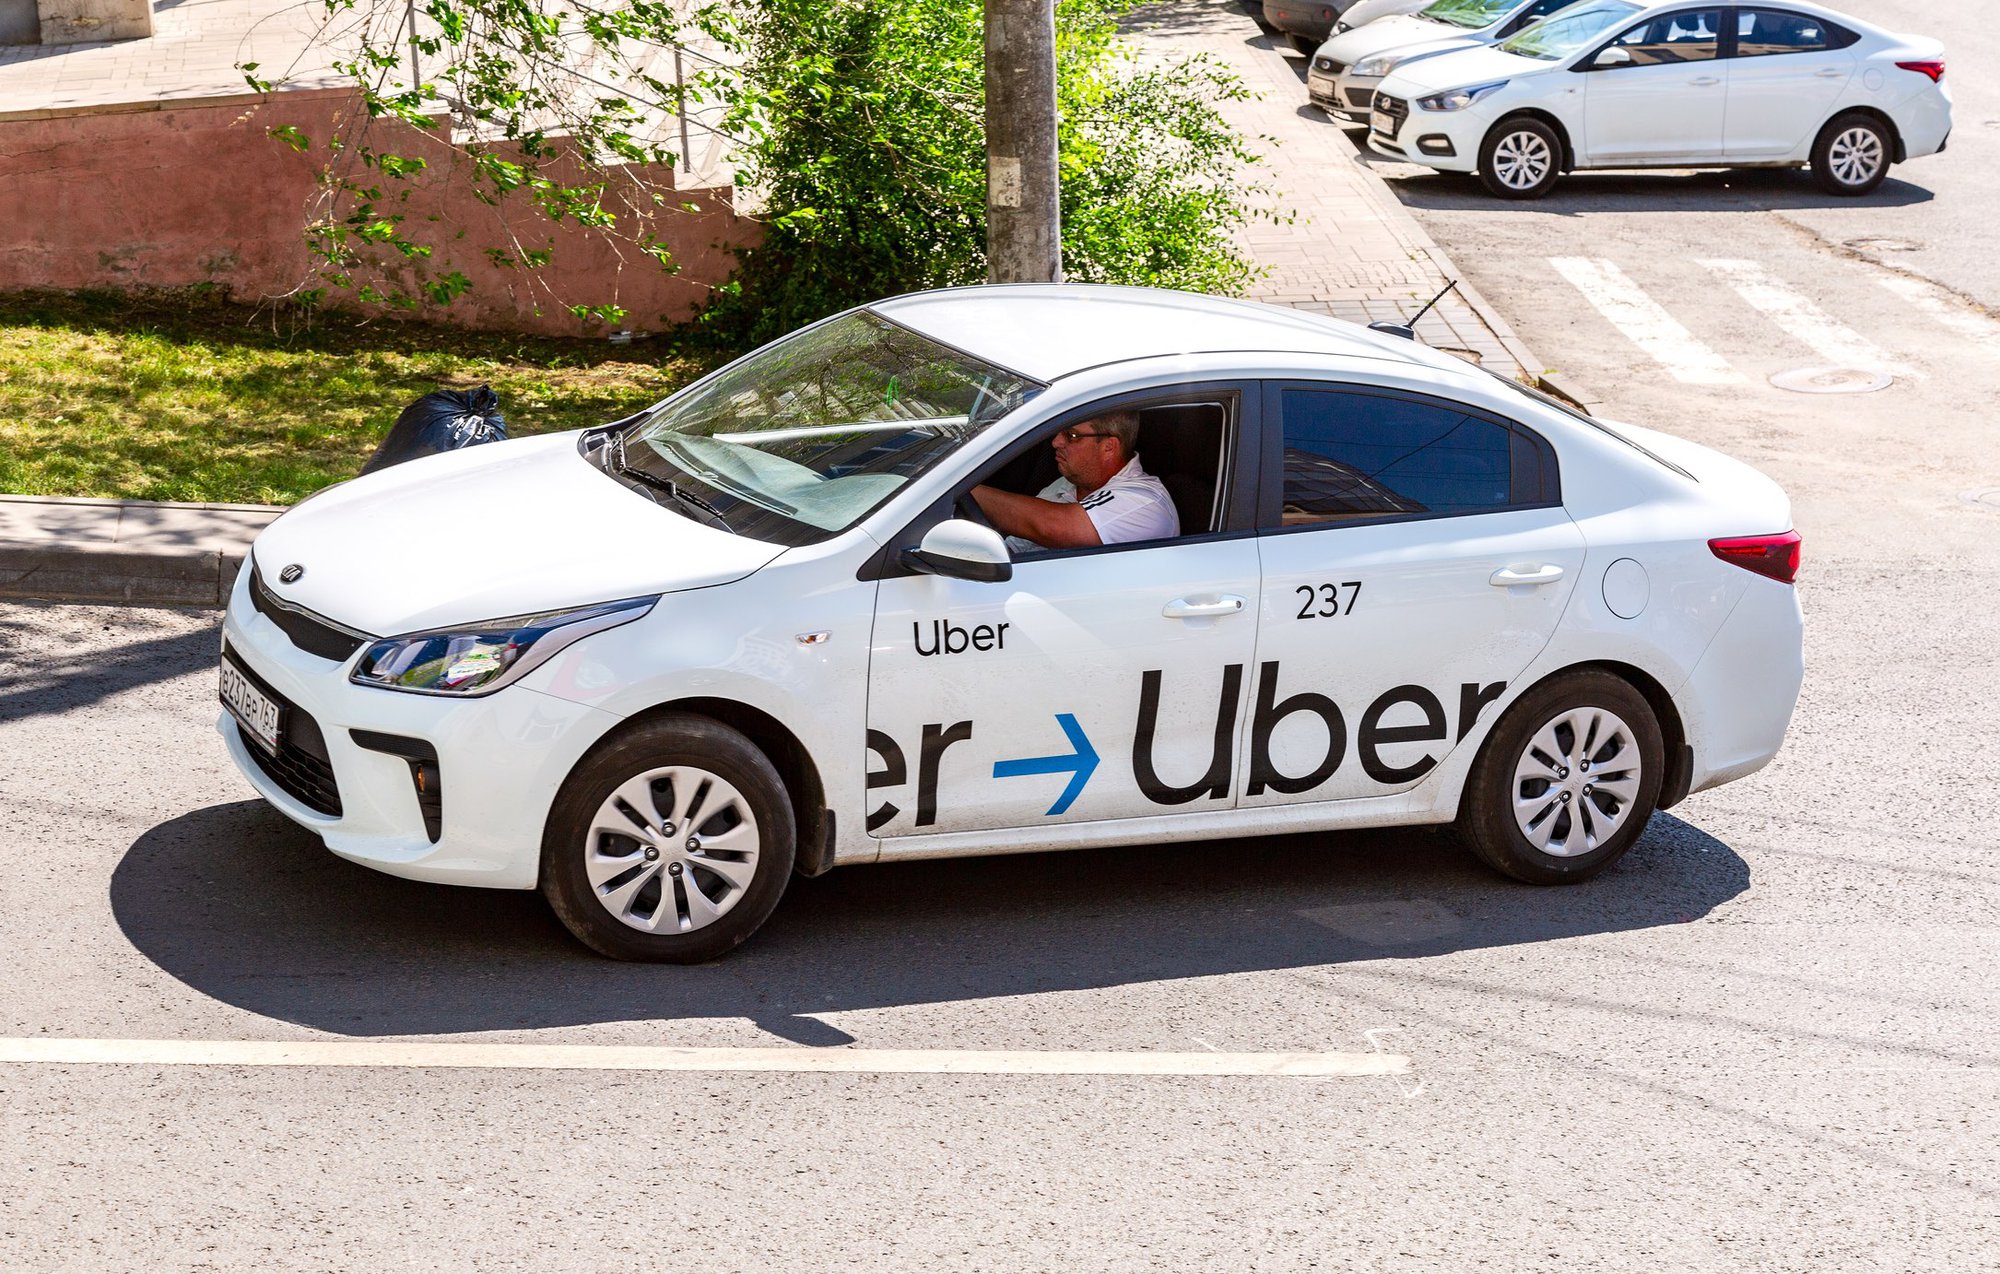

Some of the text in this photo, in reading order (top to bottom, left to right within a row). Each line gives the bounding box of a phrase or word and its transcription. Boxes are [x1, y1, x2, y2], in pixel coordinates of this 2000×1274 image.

[1295, 581, 1362, 620] 237
[914, 619, 1010, 657] Uber
[1132, 660, 1508, 806] Uber
